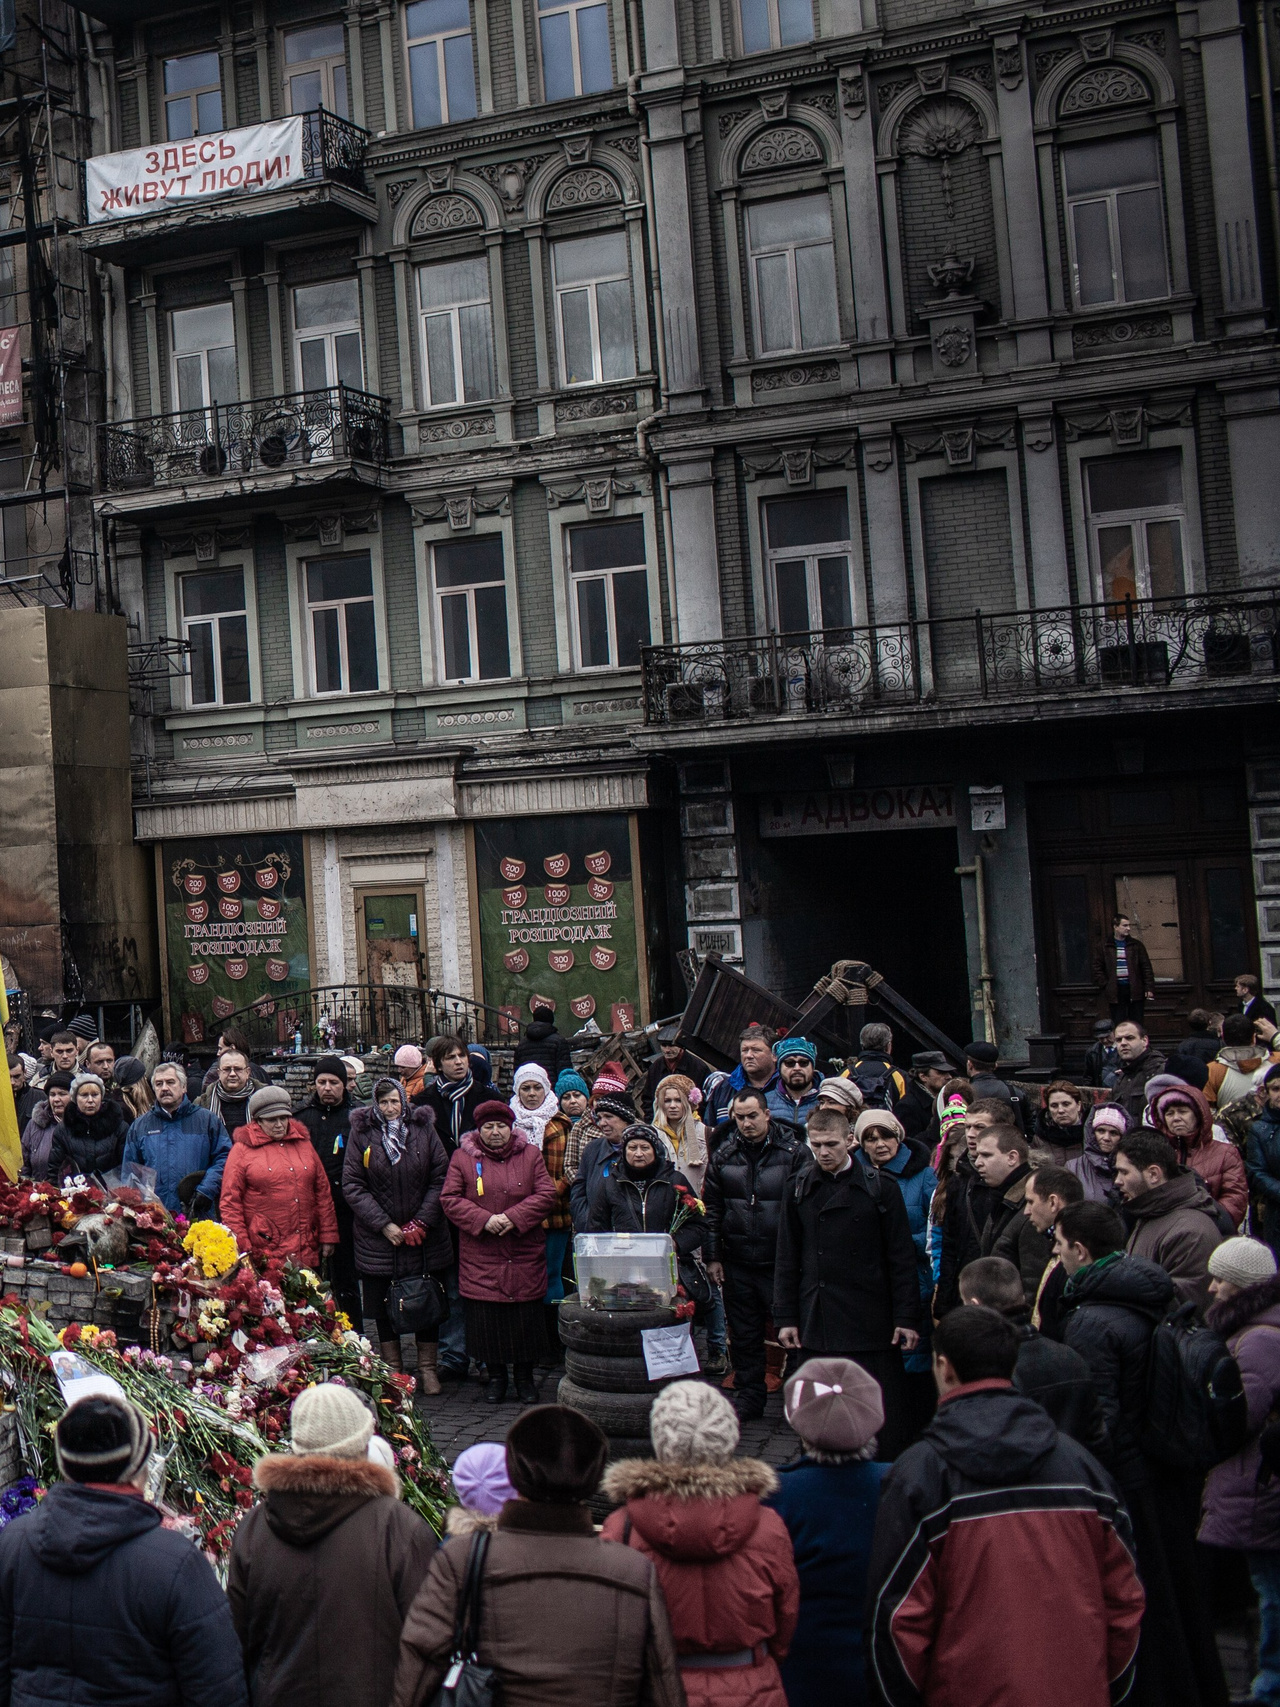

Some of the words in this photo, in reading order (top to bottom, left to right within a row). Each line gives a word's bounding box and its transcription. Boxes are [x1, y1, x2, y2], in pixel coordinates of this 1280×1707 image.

[145, 139, 236, 175] ЗДЕСЬ
[101, 174, 193, 211] ЖИВУТ
[199, 155, 291, 193] ЛЮДИ!
[549, 859, 564, 869] 500
[591, 857, 606, 867] 150
[505, 864, 519, 874] 200
[260, 873, 273, 882] 150
[592, 884, 608, 894] 300
[507, 891, 522, 901] 700
[190, 907, 204, 915] 700
[222, 903, 238, 912] 1000
[261, 903, 275, 912] 300
[501, 900, 617, 925] ГРАНДІОЗНИЙ
[184, 917, 287, 939] ГРАНДІОЗНИЙ
[509, 924, 612, 944] РОЗПРОДАЖ
[190, 938, 282, 956] РОЗПРОДАЖ
[509, 954, 524, 965] 150
[595, 952, 609, 962] 400
[192, 968, 204, 977] 150
[230, 964, 243, 972] 300
[576, 1001, 590, 1012] 200
[617, 1008, 632, 1030] SALE
[187, 1017, 203, 1041] SALE
